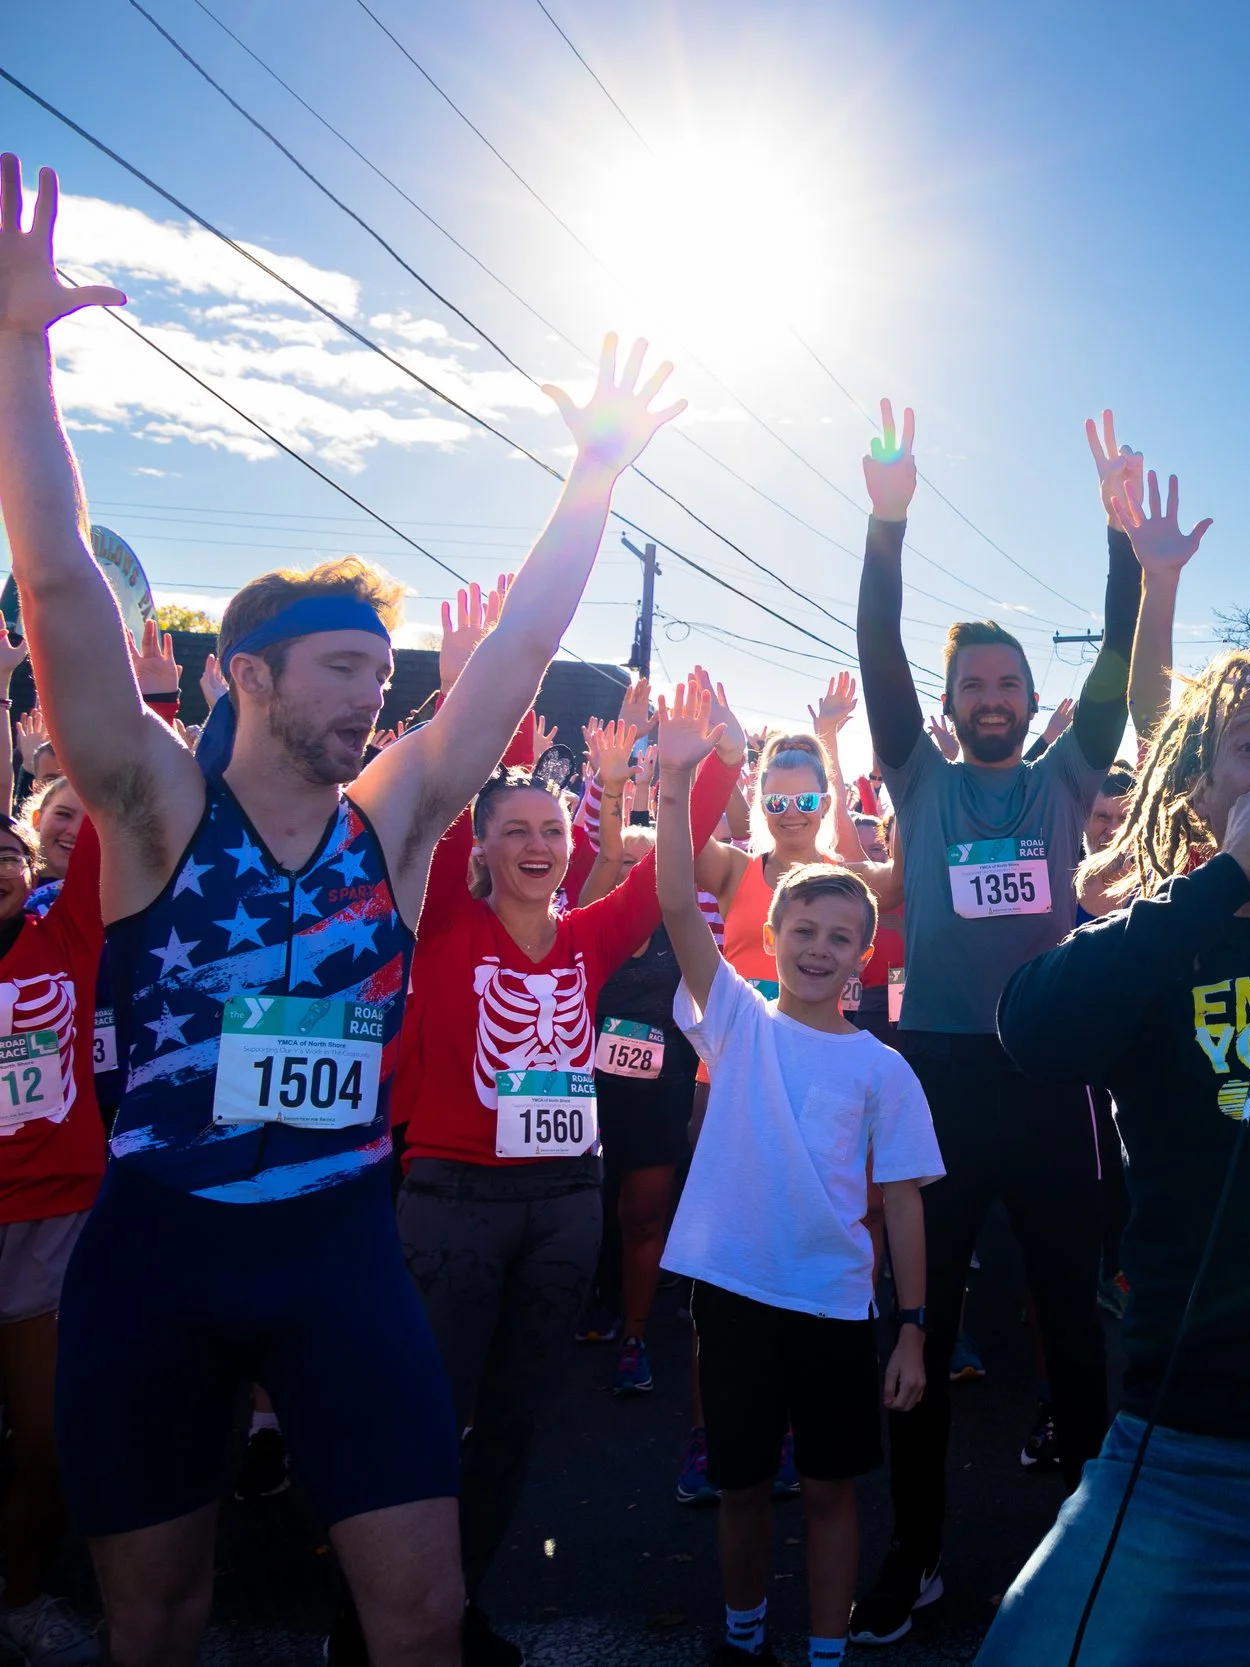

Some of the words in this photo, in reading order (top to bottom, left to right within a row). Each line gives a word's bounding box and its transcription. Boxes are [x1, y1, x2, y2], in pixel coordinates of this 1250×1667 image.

[1020, 839, 1044, 847] ROAD
[1019, 847, 1045, 857] RACE
[969, 872, 1036, 906] 1355
[230, 1010, 245, 1019] the
[354, 1006, 383, 1021] ROAD
[350, 1021, 383, 1037] RACE
[0, 1038, 26, 1050] ROAD
[649, 1034, 665, 1042] RACE
[327, 1041, 346, 1049] Shore
[0, 1048, 28, 1060] RACE
[608, 1043, 653, 1071] 1528
[253, 1055, 363, 1109] 1504
[571, 1075, 593, 1083] ROAD
[570, 1083, 595, 1094] RACE
[519, 1108, 583, 1144] 1560
